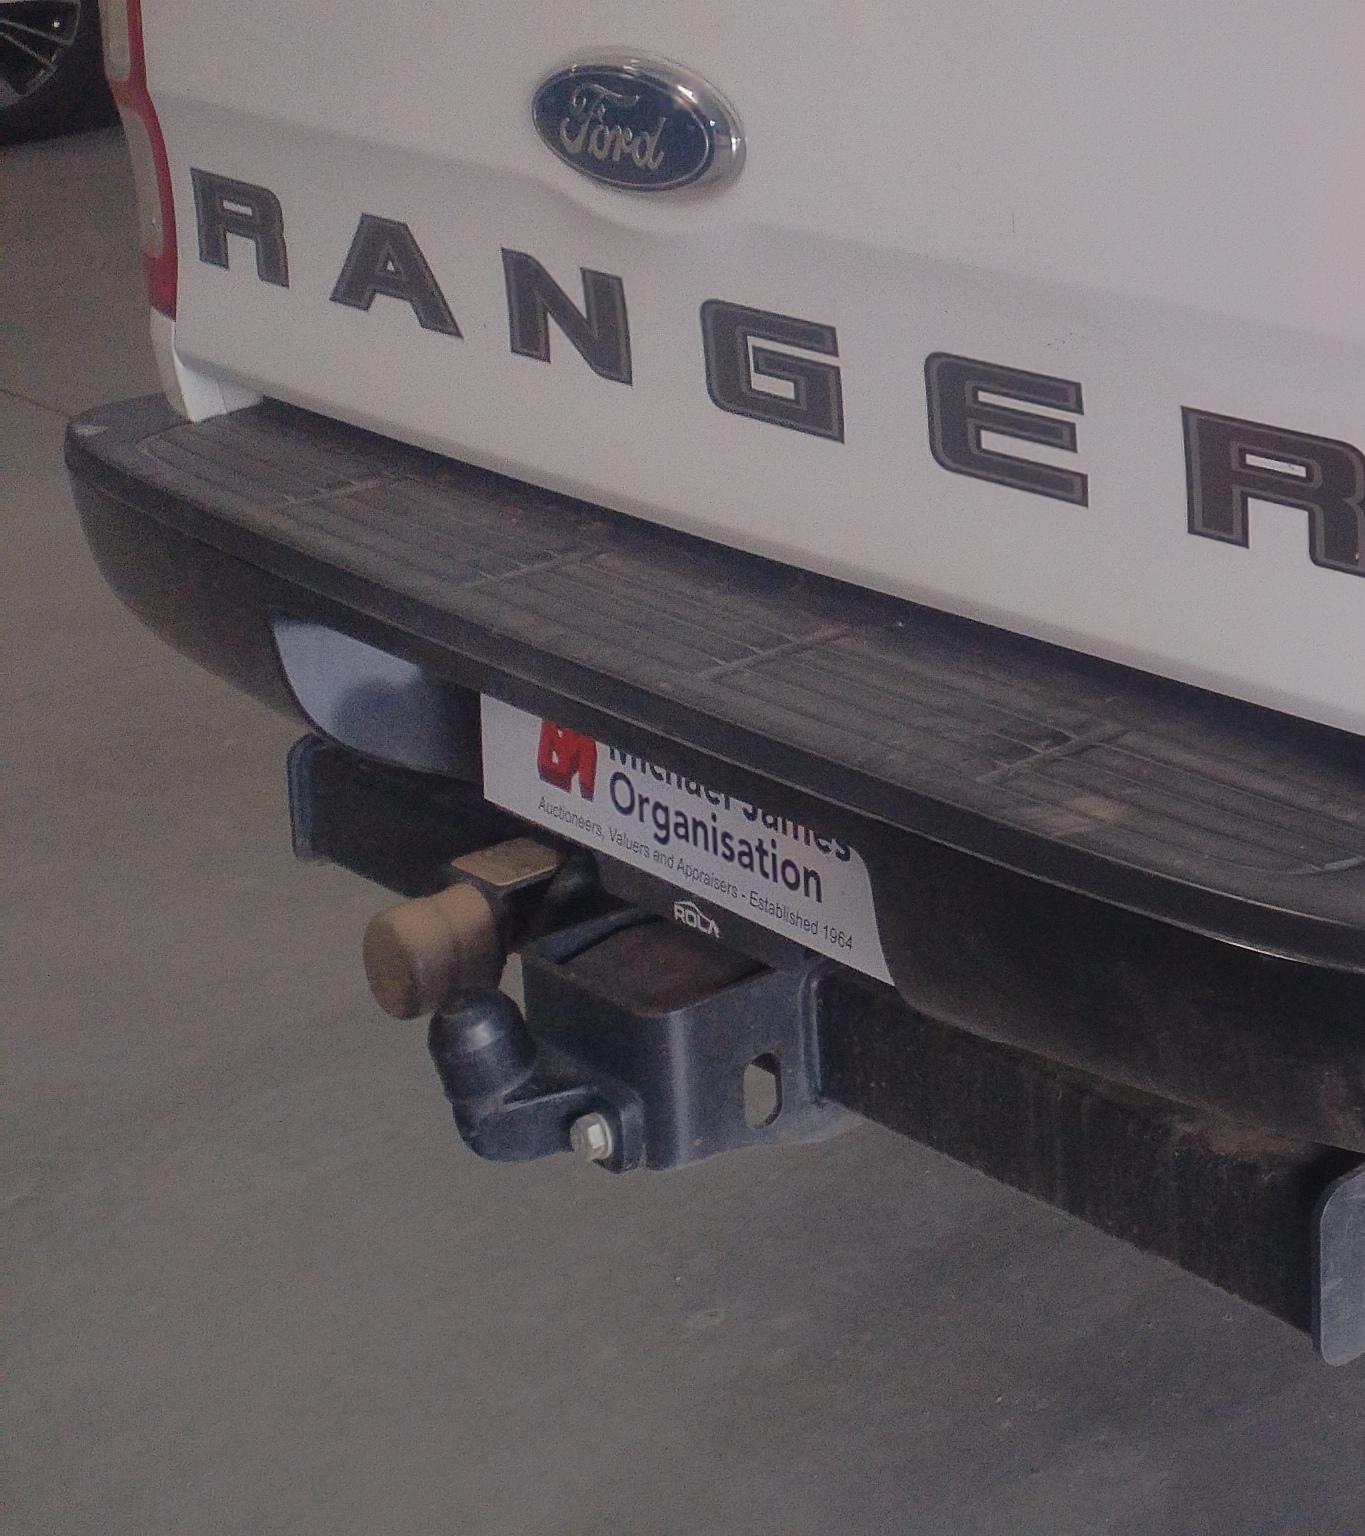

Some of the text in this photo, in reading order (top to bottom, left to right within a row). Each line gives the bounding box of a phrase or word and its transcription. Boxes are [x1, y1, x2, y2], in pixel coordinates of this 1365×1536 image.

[557, 83, 670, 170] Ford
[538, 796, 605, 842] Auctioneers,
[609, 827, 650, 860] Valuers
[653, 849, 674, 869] and
[676, 858, 738, 898] Appraisers
[749, 891, 818, 935] Established
[823, 924, 853, 950] 1964
[609, 771, 822, 903] Organisation
[672, 901, 720, 938] ROLA
